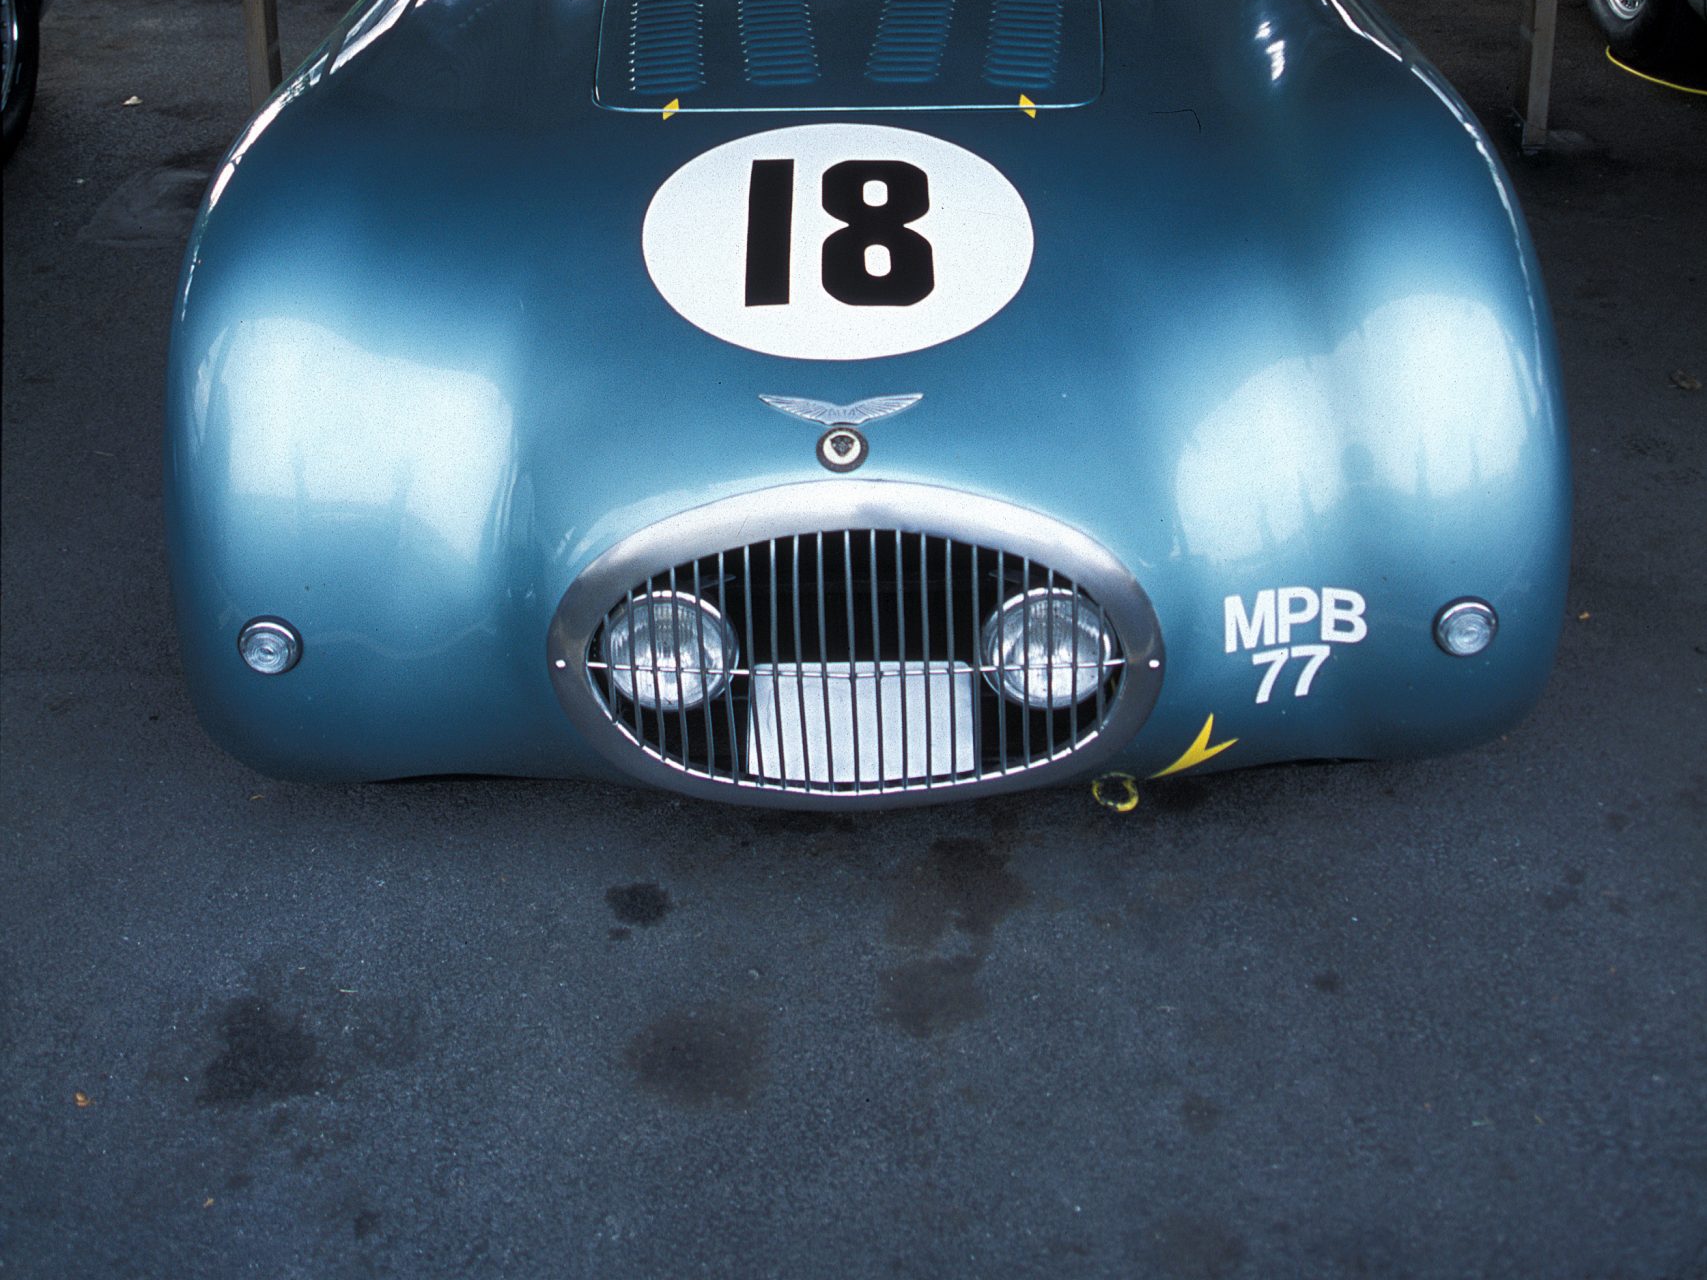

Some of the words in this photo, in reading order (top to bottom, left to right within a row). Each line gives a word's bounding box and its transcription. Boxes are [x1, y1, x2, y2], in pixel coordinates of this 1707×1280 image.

[744, 158, 935, 307] 18
[1224, 586, 1367, 653] MPB
[1252, 644, 1331, 704] 77
